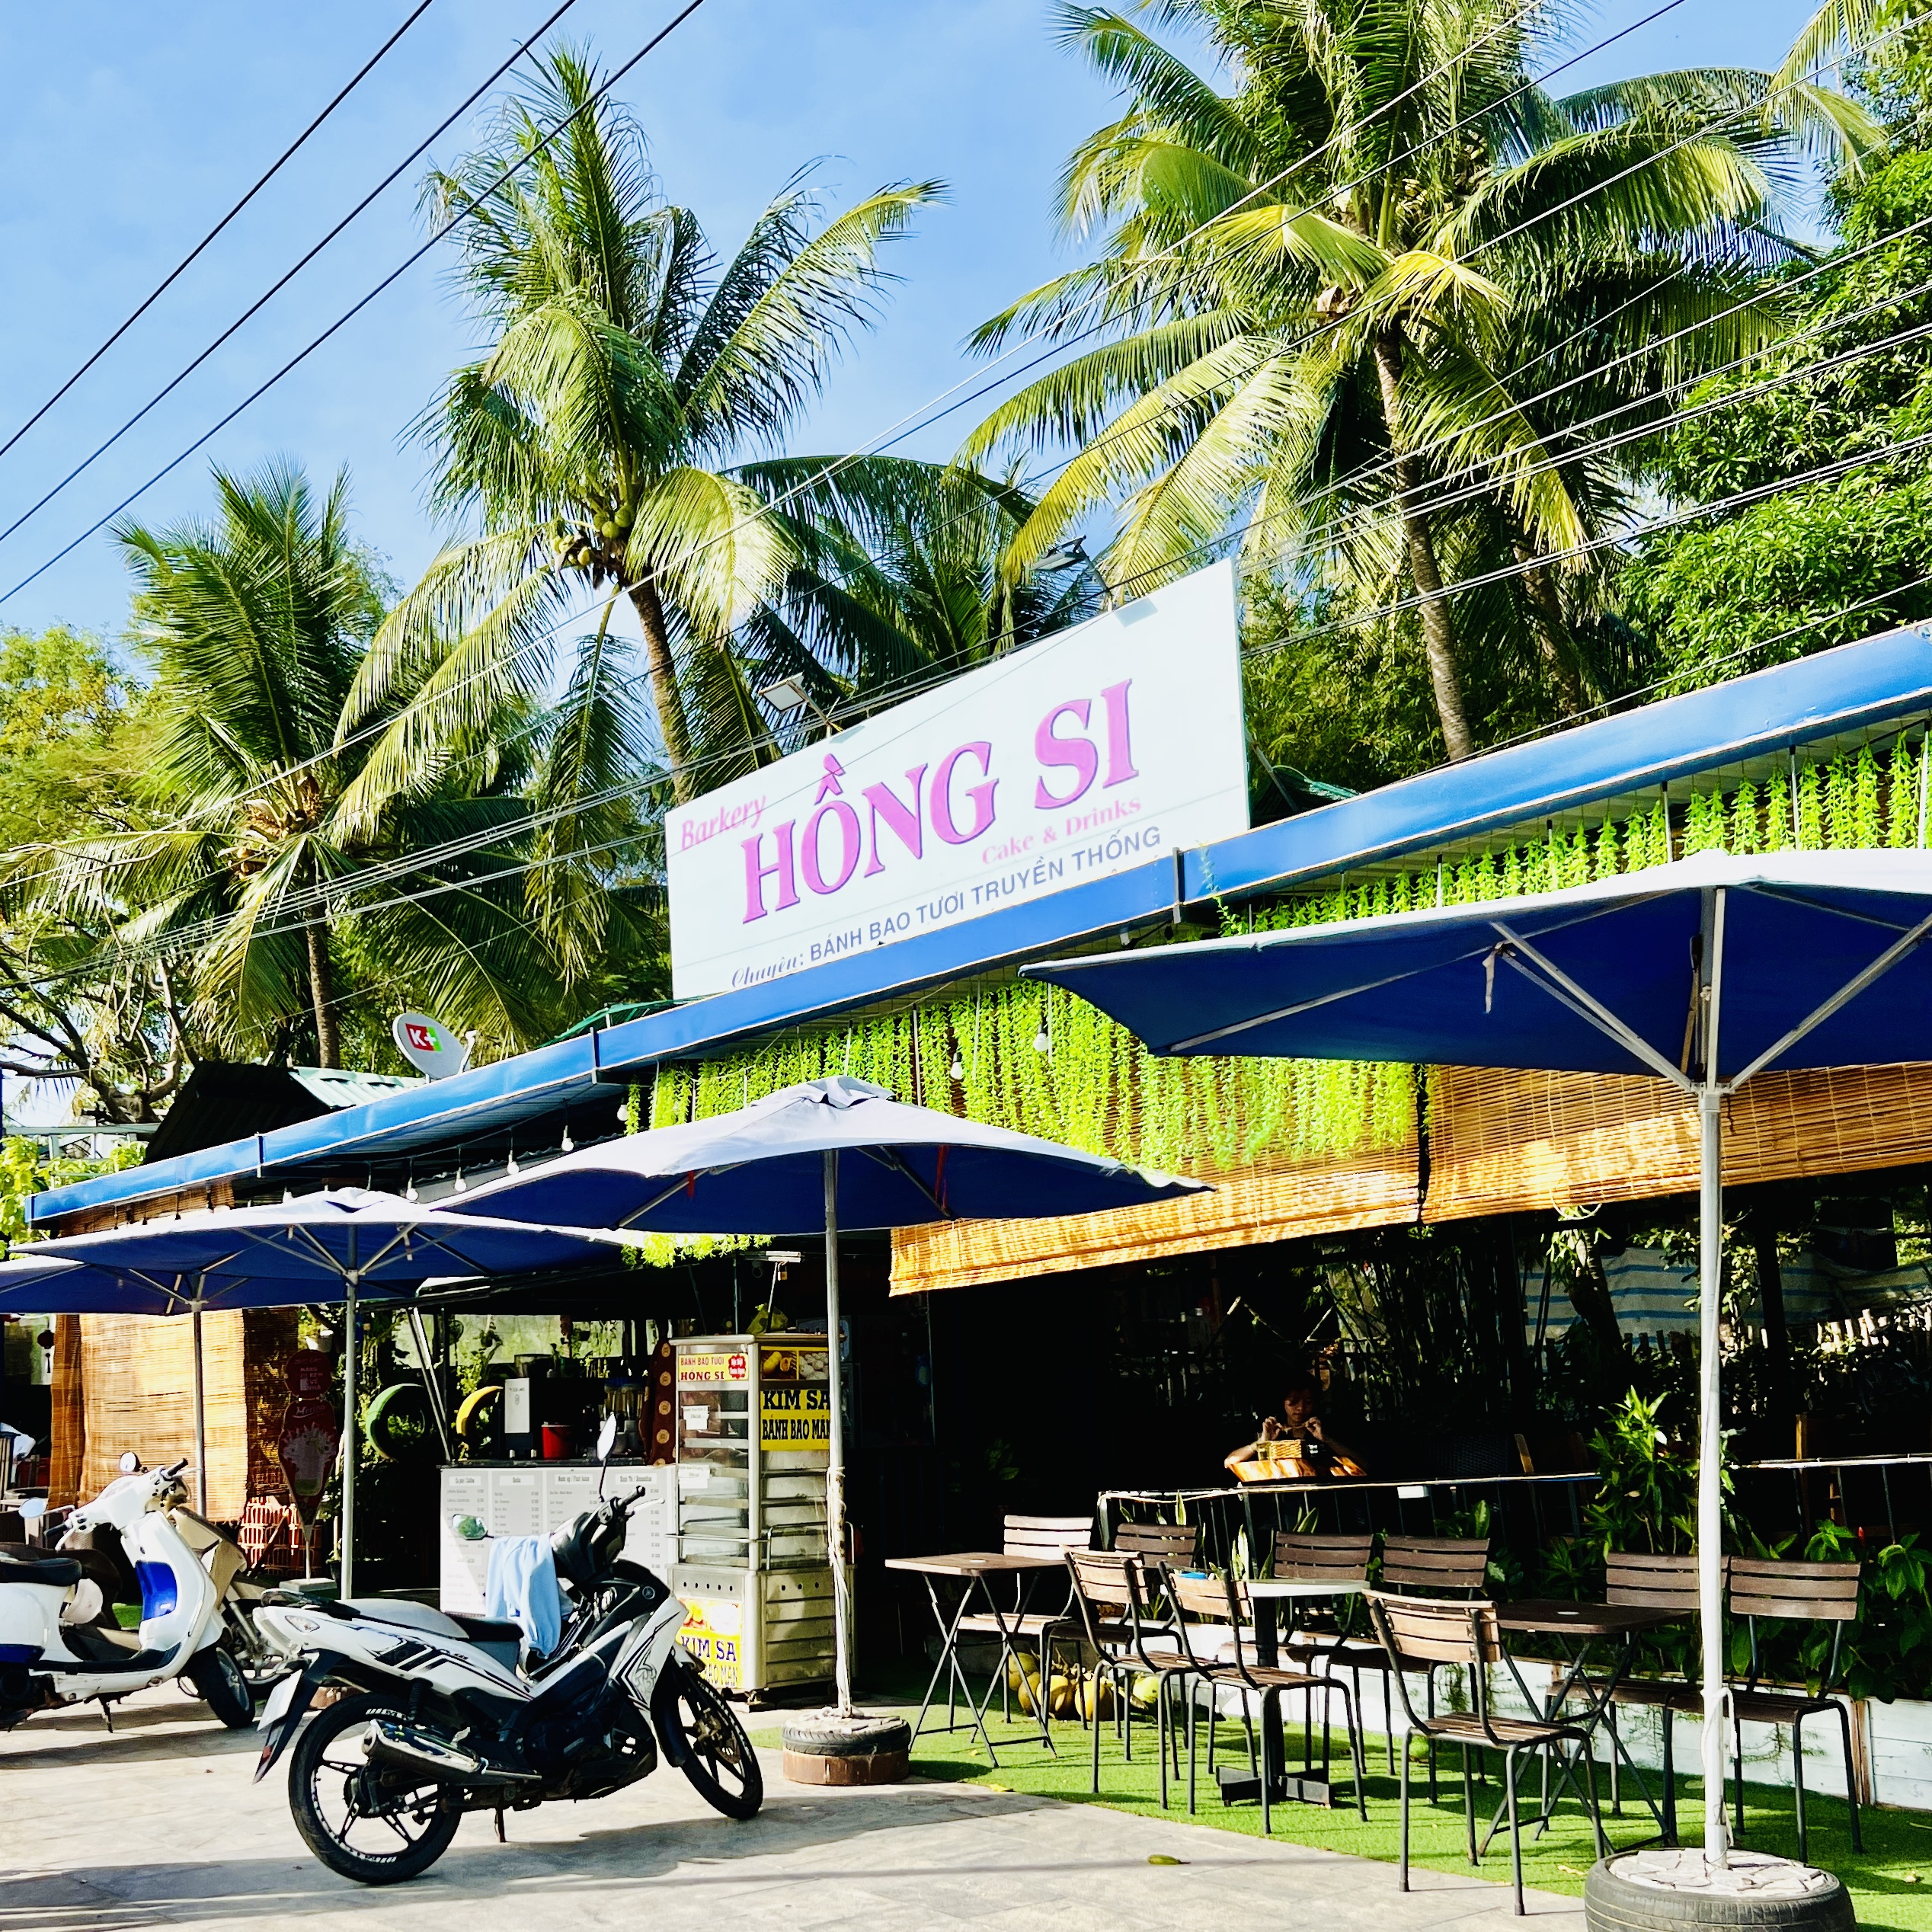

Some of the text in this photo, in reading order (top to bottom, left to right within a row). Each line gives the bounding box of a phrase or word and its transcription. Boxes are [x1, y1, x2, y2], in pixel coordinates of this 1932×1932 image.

[741, 678, 1139, 924] HỒNG SI
[680, 795, 766, 850] Barkery
[981, 797, 1141, 865] Cake & Drinks
[810, 927, 862, 961] BÁNH
[869, 912, 910, 940] BAO
[916, 891, 964, 923] TƯƠI
[971, 856, 1064, 905] TRUYỀN
[1071, 826, 1161, 872] THỐNG
[409, 1028, 437, 1047] K+
[715, 1371, 724, 1380] SI
[763, 1390, 830, 1410] KIM SA
[791, 1419, 810, 1440] BAO
[716, 1639, 737, 1662] SA
